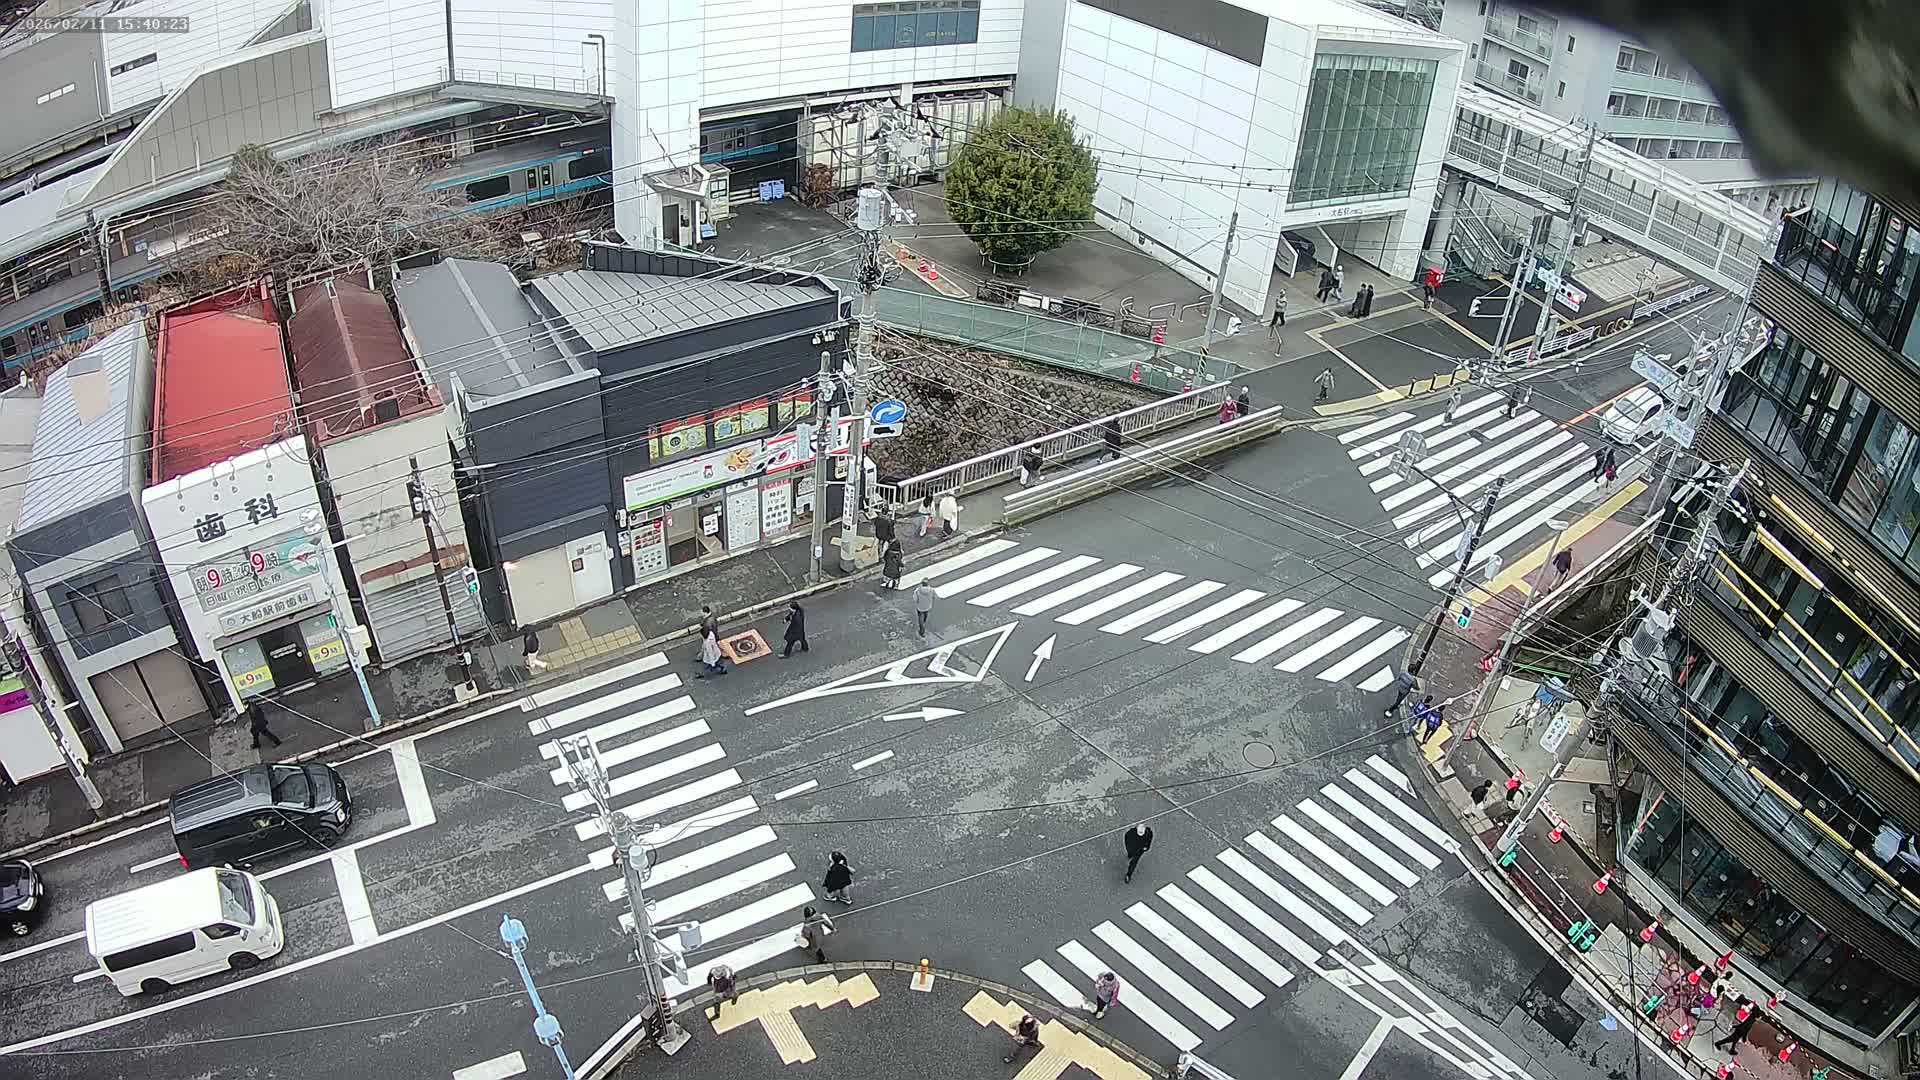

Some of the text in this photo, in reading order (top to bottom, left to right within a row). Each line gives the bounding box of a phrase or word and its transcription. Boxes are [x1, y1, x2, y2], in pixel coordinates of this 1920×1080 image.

[193, 492, 279, 543] 歯科
[240, 592, 308, 624] 大船駅前歯科
